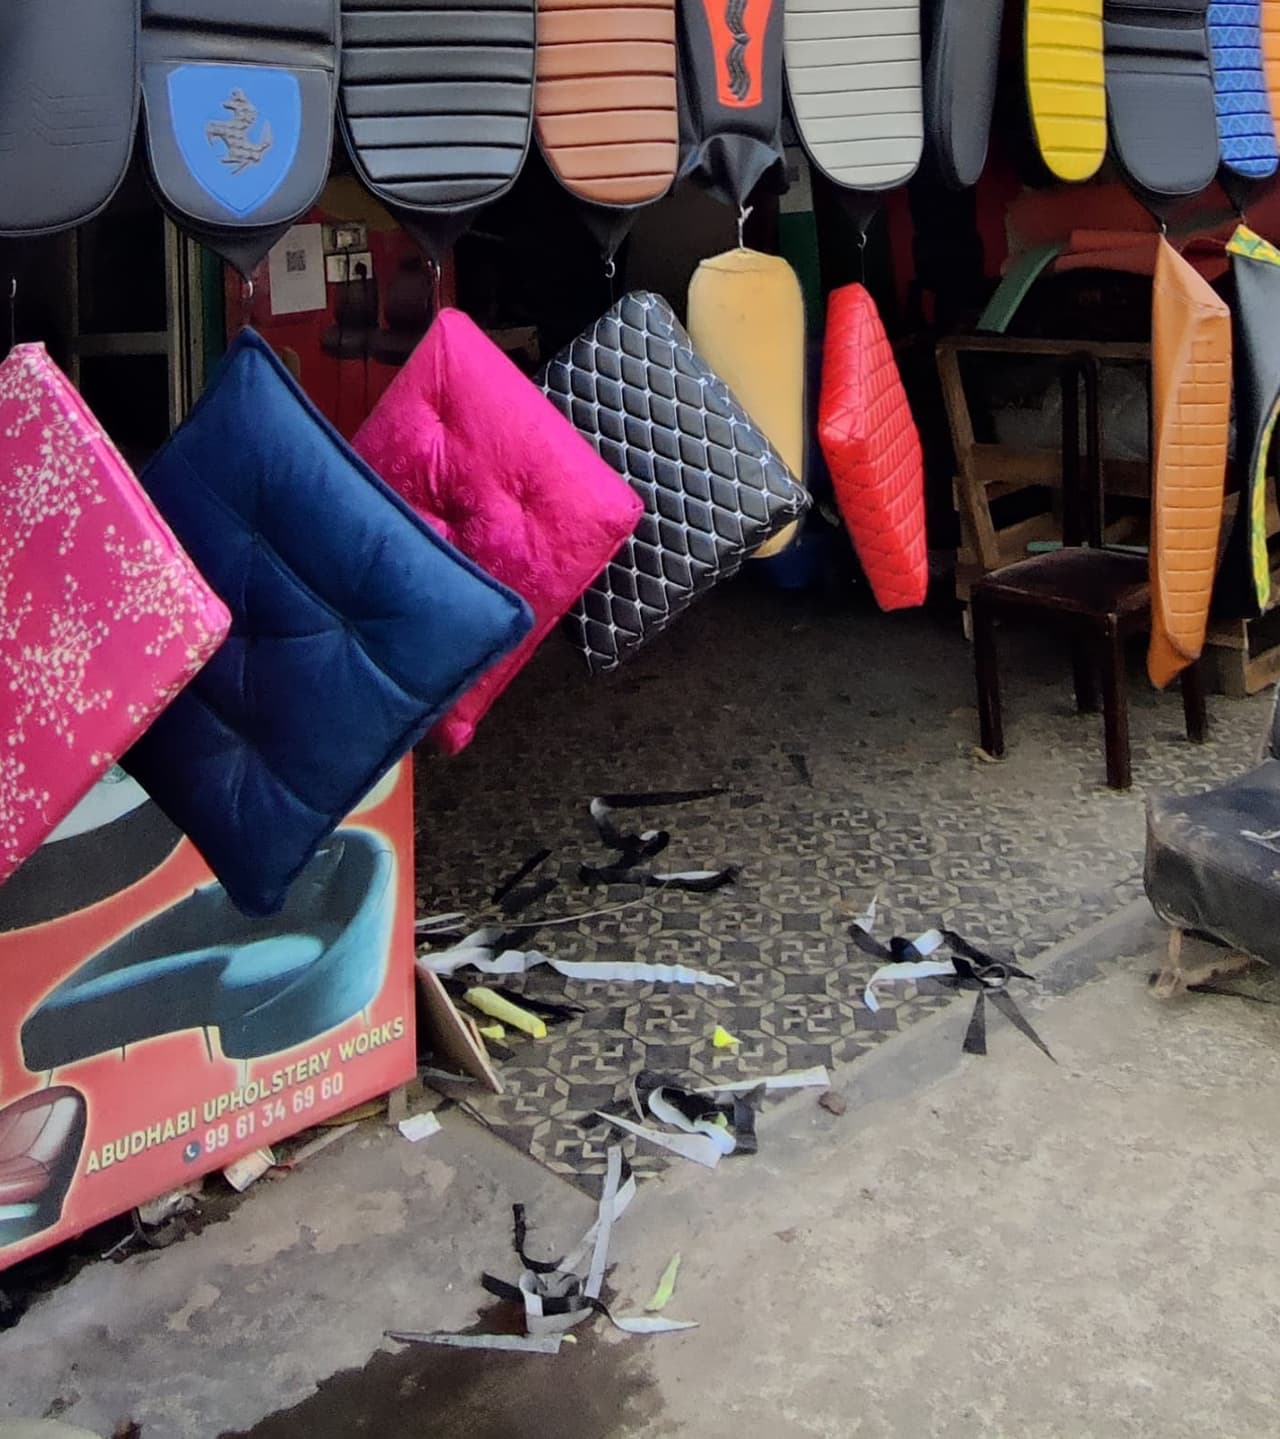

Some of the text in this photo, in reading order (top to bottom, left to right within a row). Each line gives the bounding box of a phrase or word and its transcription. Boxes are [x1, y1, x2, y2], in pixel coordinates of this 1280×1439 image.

[86, 1015, 405, 1175] ABUDHABI UPHOLSTERY WORKS
[204, 1071, 345, 1154] 99 61 34 69 60
